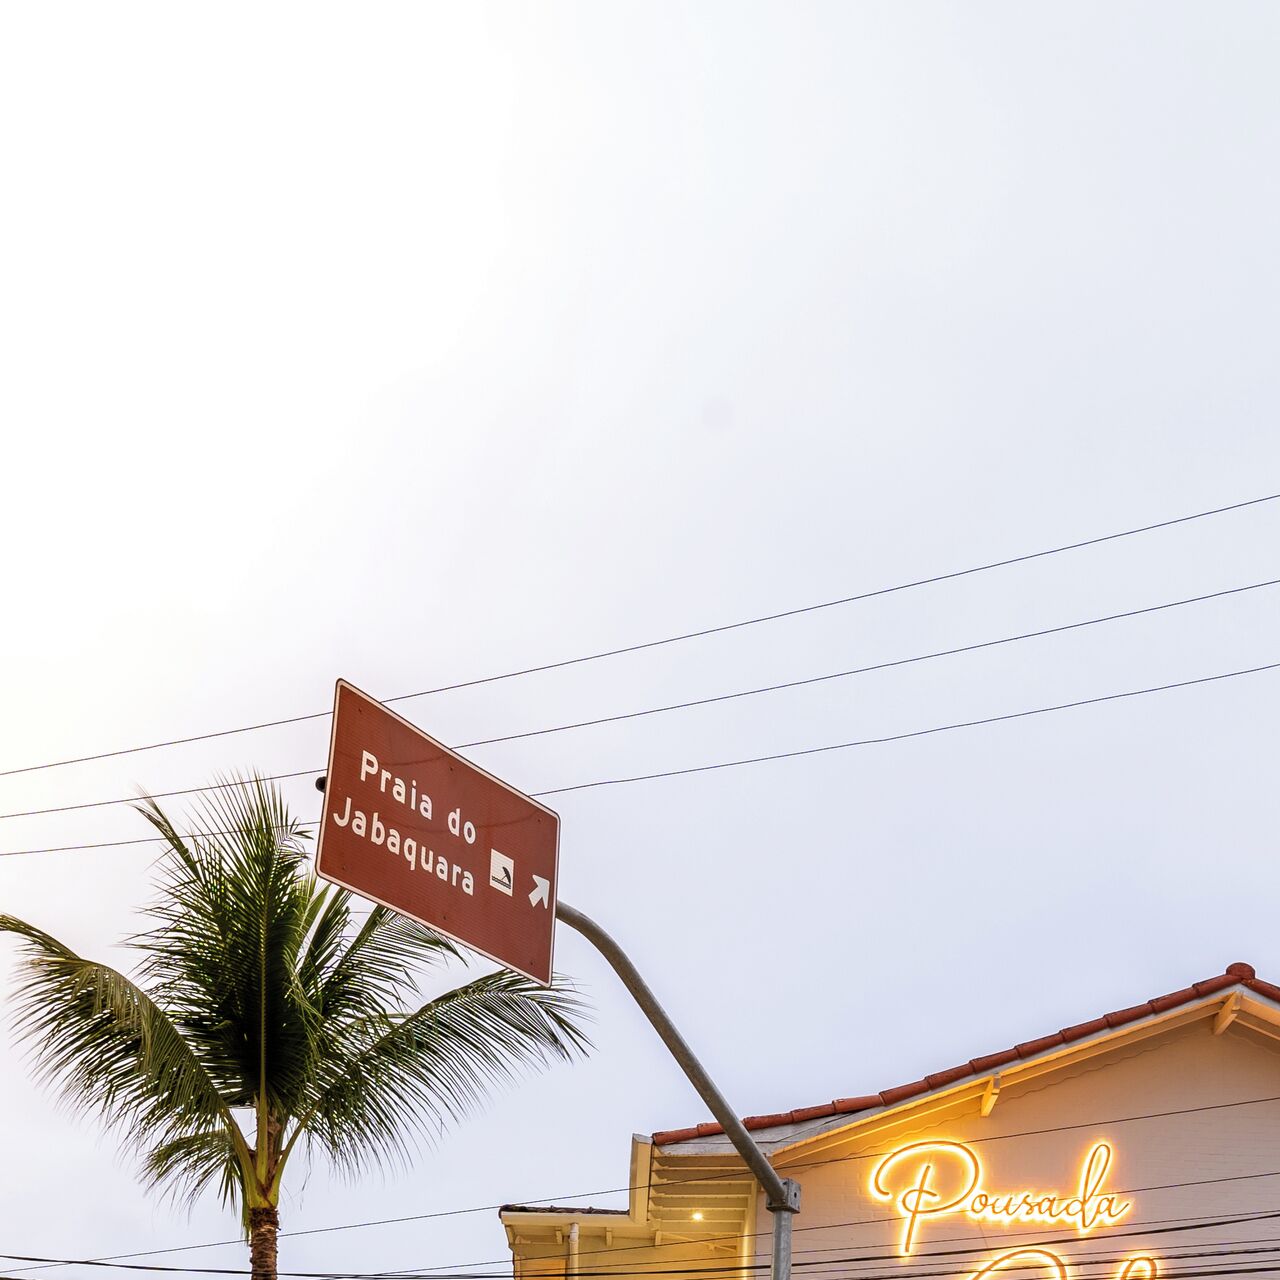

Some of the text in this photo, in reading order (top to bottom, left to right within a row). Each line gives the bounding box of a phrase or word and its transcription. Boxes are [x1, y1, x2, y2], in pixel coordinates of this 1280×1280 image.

[333, 797, 474, 896] Jabaquara
[360, 750, 477, 844] Praia do
[872, 1138, 1131, 1255] Pousada
